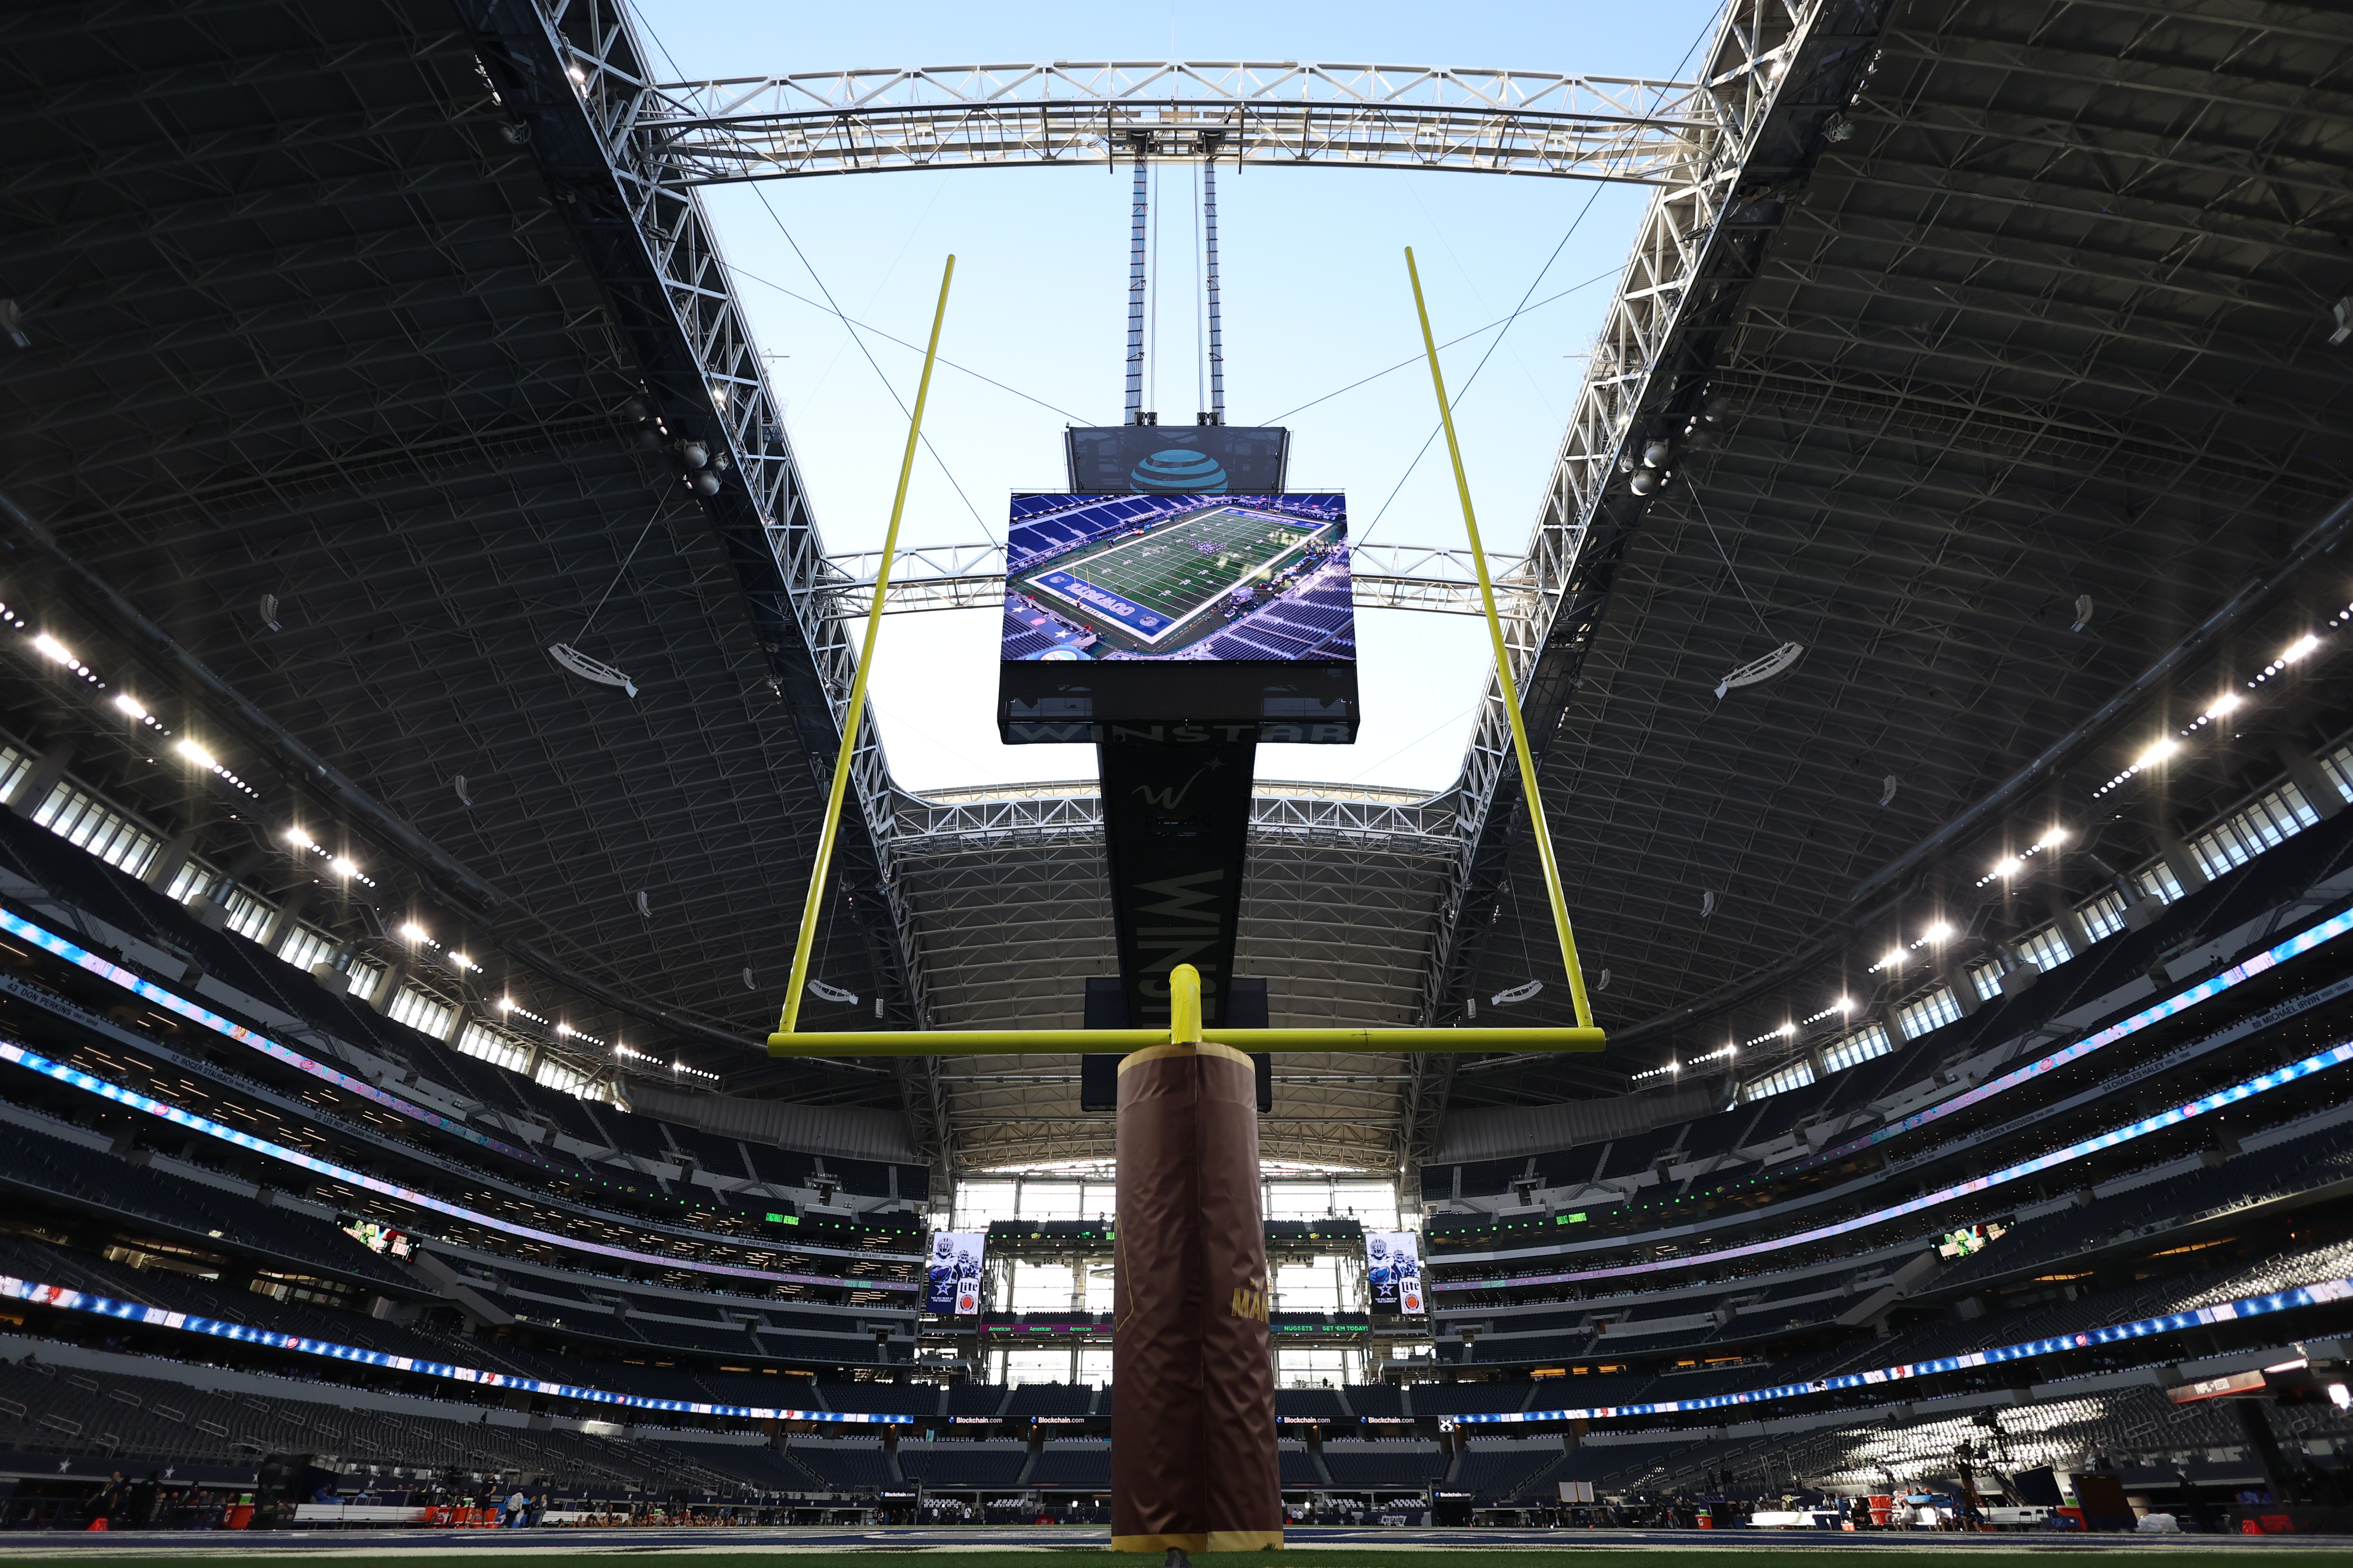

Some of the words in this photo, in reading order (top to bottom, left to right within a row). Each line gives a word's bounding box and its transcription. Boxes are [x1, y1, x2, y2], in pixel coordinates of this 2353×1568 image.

[1008, 724, 1351, 742] WINSTAR
[6, 983, 18, 992] 43
[21, 989, 38, 1001] DON
[40, 997, 72, 1016] PERKINS
[2262, 1005, 2298, 1024] MICHAEL
[2298, 995, 2320, 1009] IRVIN
[181, 1059, 203, 1072] ROGER
[203, 1068, 234, 1085] STAUBACH
[2111, 1071, 2142, 1088] CHARLES
[2142, 1062, 2165, 1076] HALEY
[324, 1116, 334, 1125] LEE
[334, 1120, 345, 1130] ROY
[344, 1124, 365, 1137] JORDAN
[1982, 1127, 2005, 1140] DARREN
[2005, 1115, 2035, 1131] WOODSON
[441, 1162, 451, 1170] TOM
[451, 1165, 470, 1177] LANDRY
[538, 1195, 551, 1203] TONY
[551, 1199, 574, 1209] DORSETT
[651, 1223, 675, 1233] SCHRAMM
[761, 1242, 785, 1250] PEARSON
[959, 1282, 978, 1294] Lite
[1401, 1282, 1419, 1293] Lite
[2194, 1383, 2212, 1394] NFL
[224, 1509, 232, 1522] G
[1698, 1518, 1704, 1526] G
